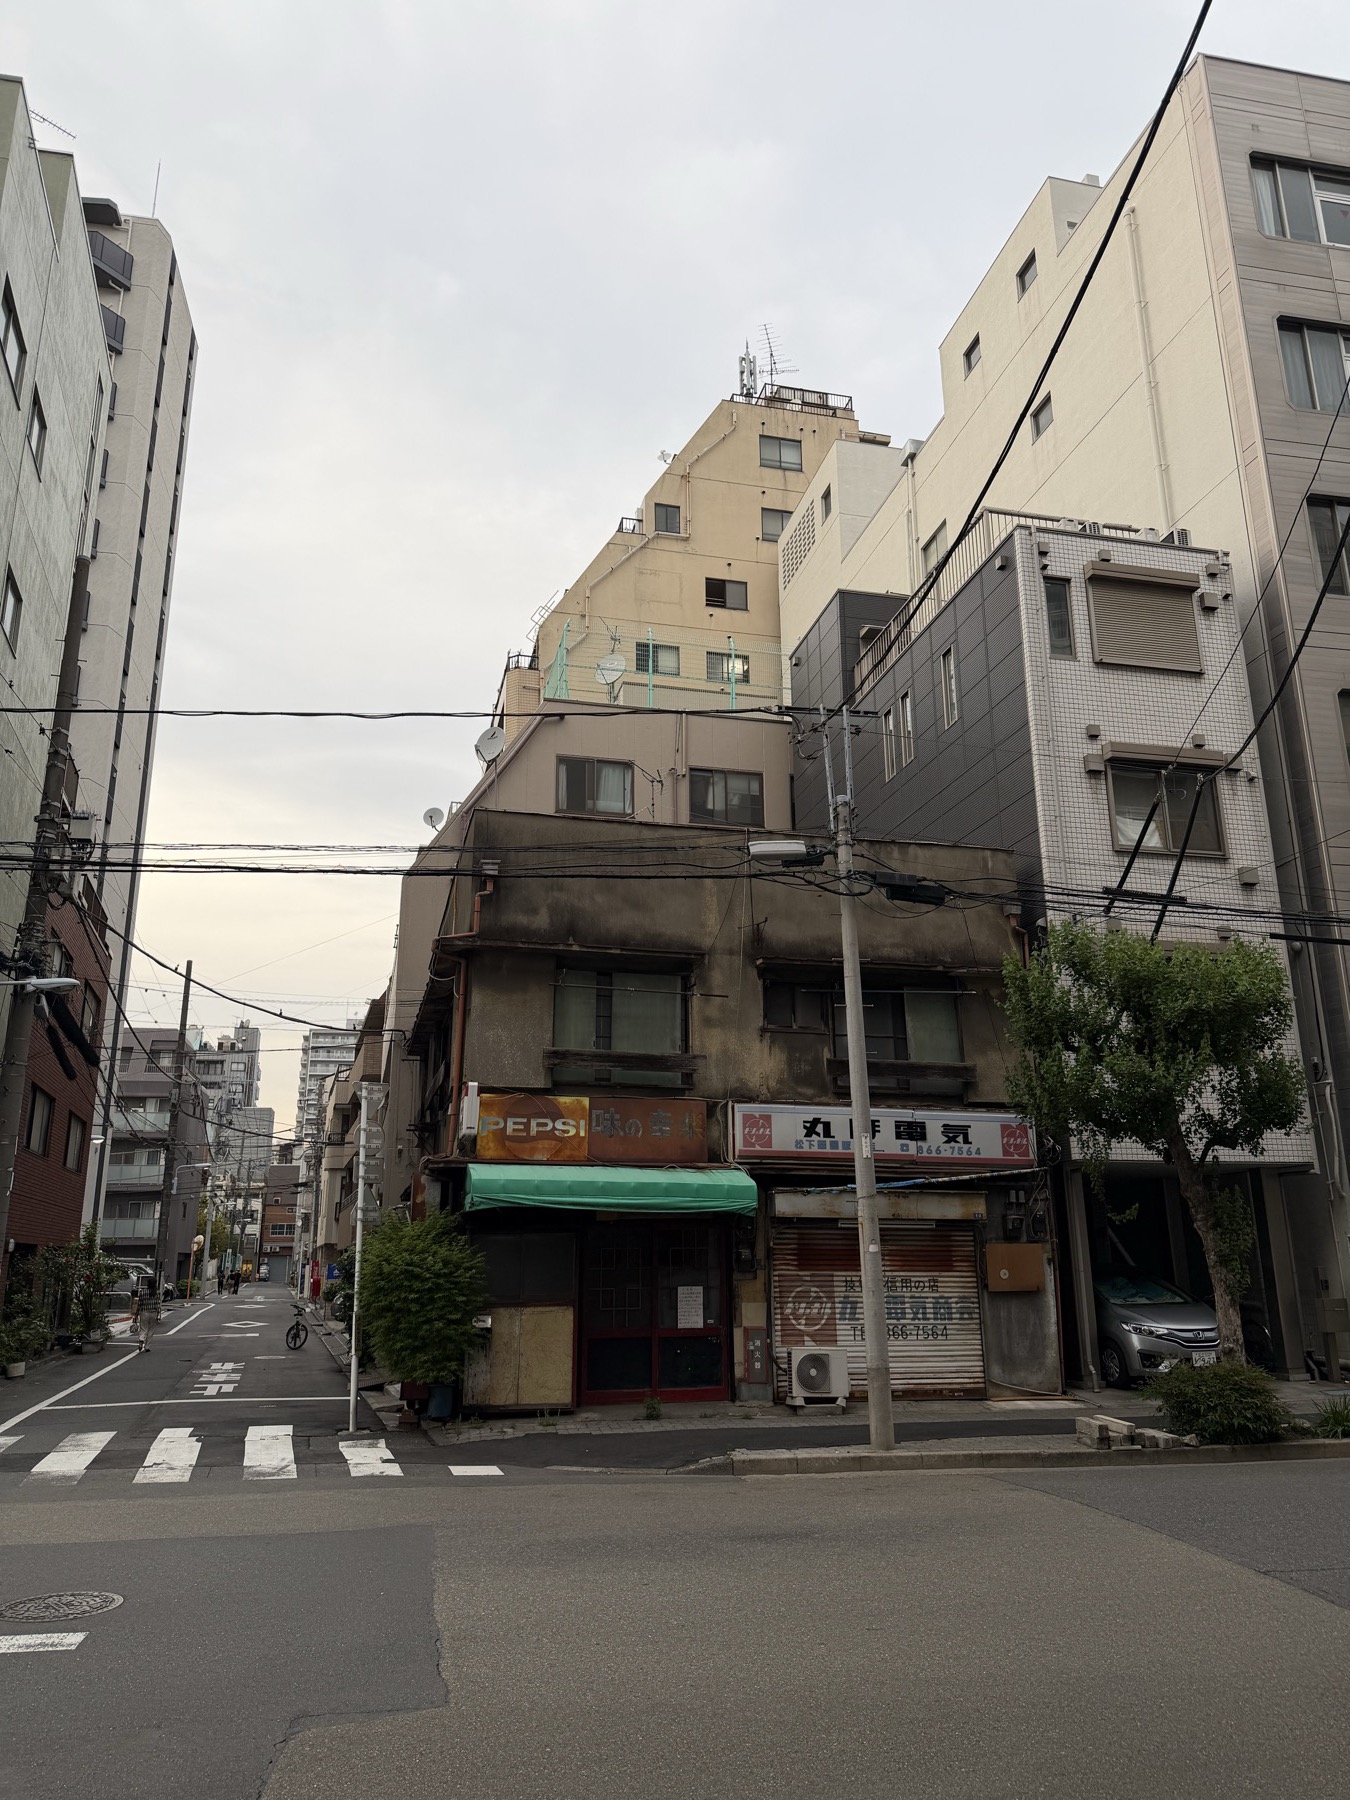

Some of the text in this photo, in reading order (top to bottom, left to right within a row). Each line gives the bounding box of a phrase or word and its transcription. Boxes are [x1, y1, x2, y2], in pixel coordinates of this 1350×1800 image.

[480, 1116, 586, 1137] PEPSI
[843, 1277, 940, 1293] 技信用の店
[839, 1294, 976, 1321] 丸電気商会
